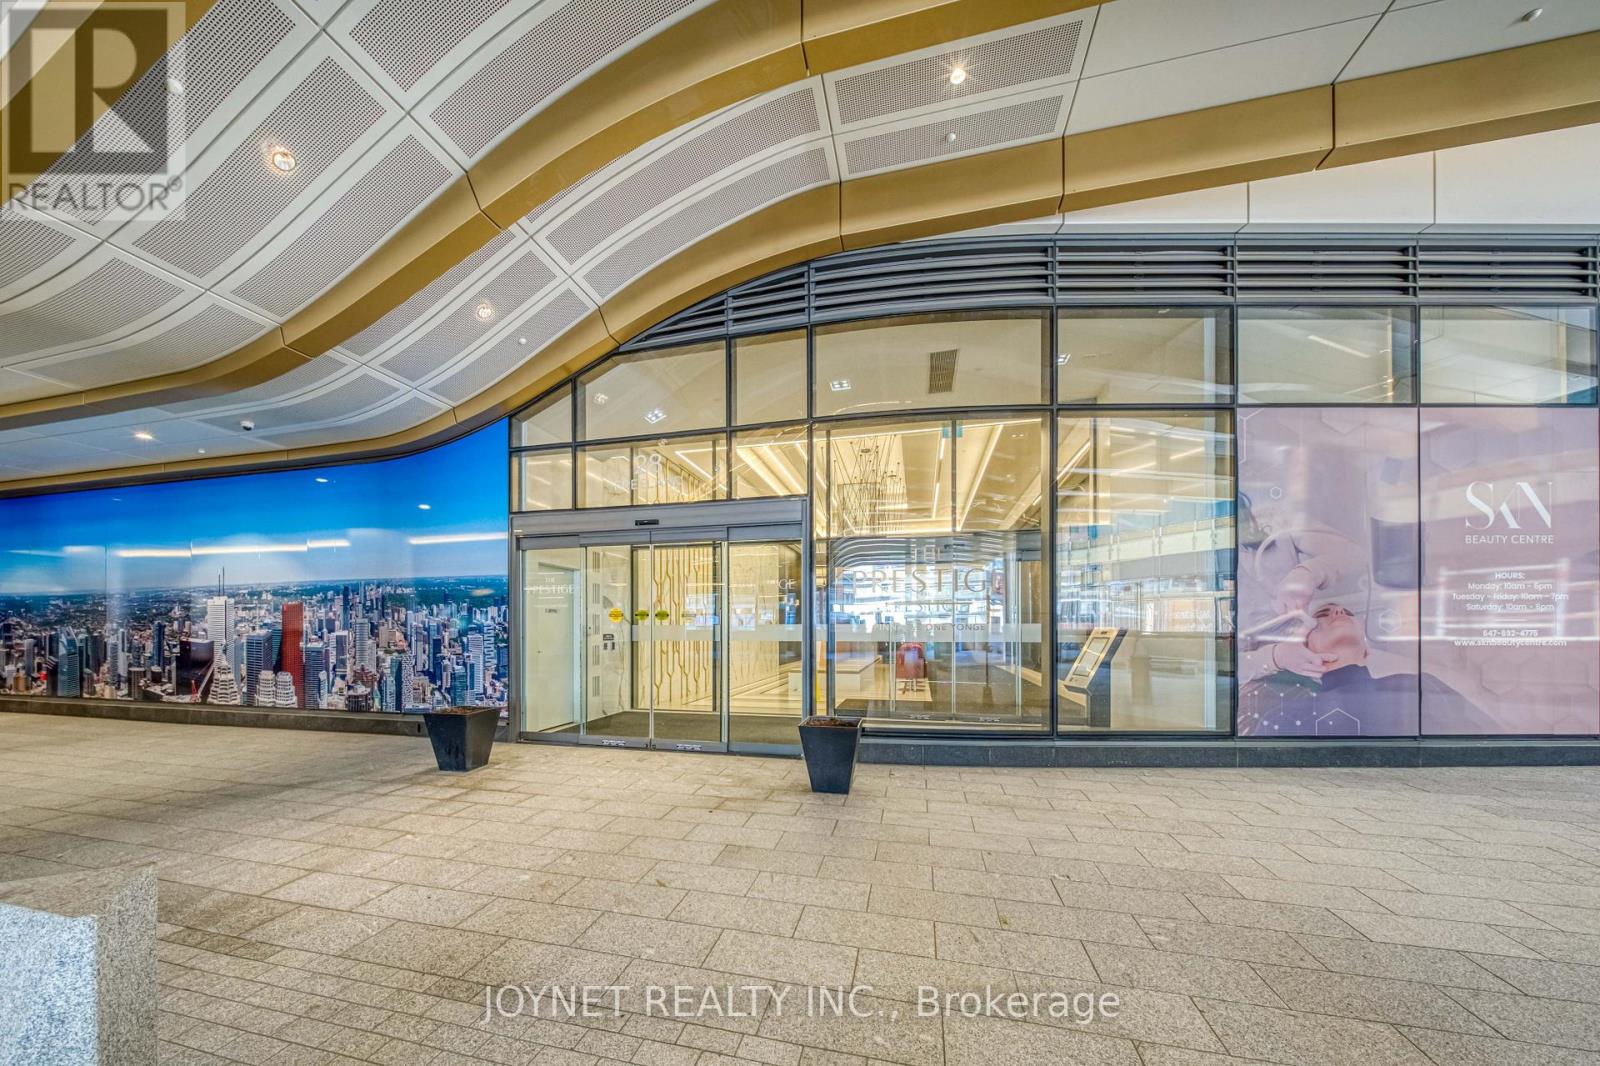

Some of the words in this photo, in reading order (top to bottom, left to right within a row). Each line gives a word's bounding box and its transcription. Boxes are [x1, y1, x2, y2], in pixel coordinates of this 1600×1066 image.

[1465, 535, 1507, 545] BEAUTY
[1511, 535, 1554, 545] CENTRE
[1495, 571, 1526, 579] HOURS:
[1468, 582, 1501, 591] Monday:
[1453, 593, 1485, 601] Tuesday
[926, 623, 947, 631] ONE
[952, 623, 985, 631] YONGE
